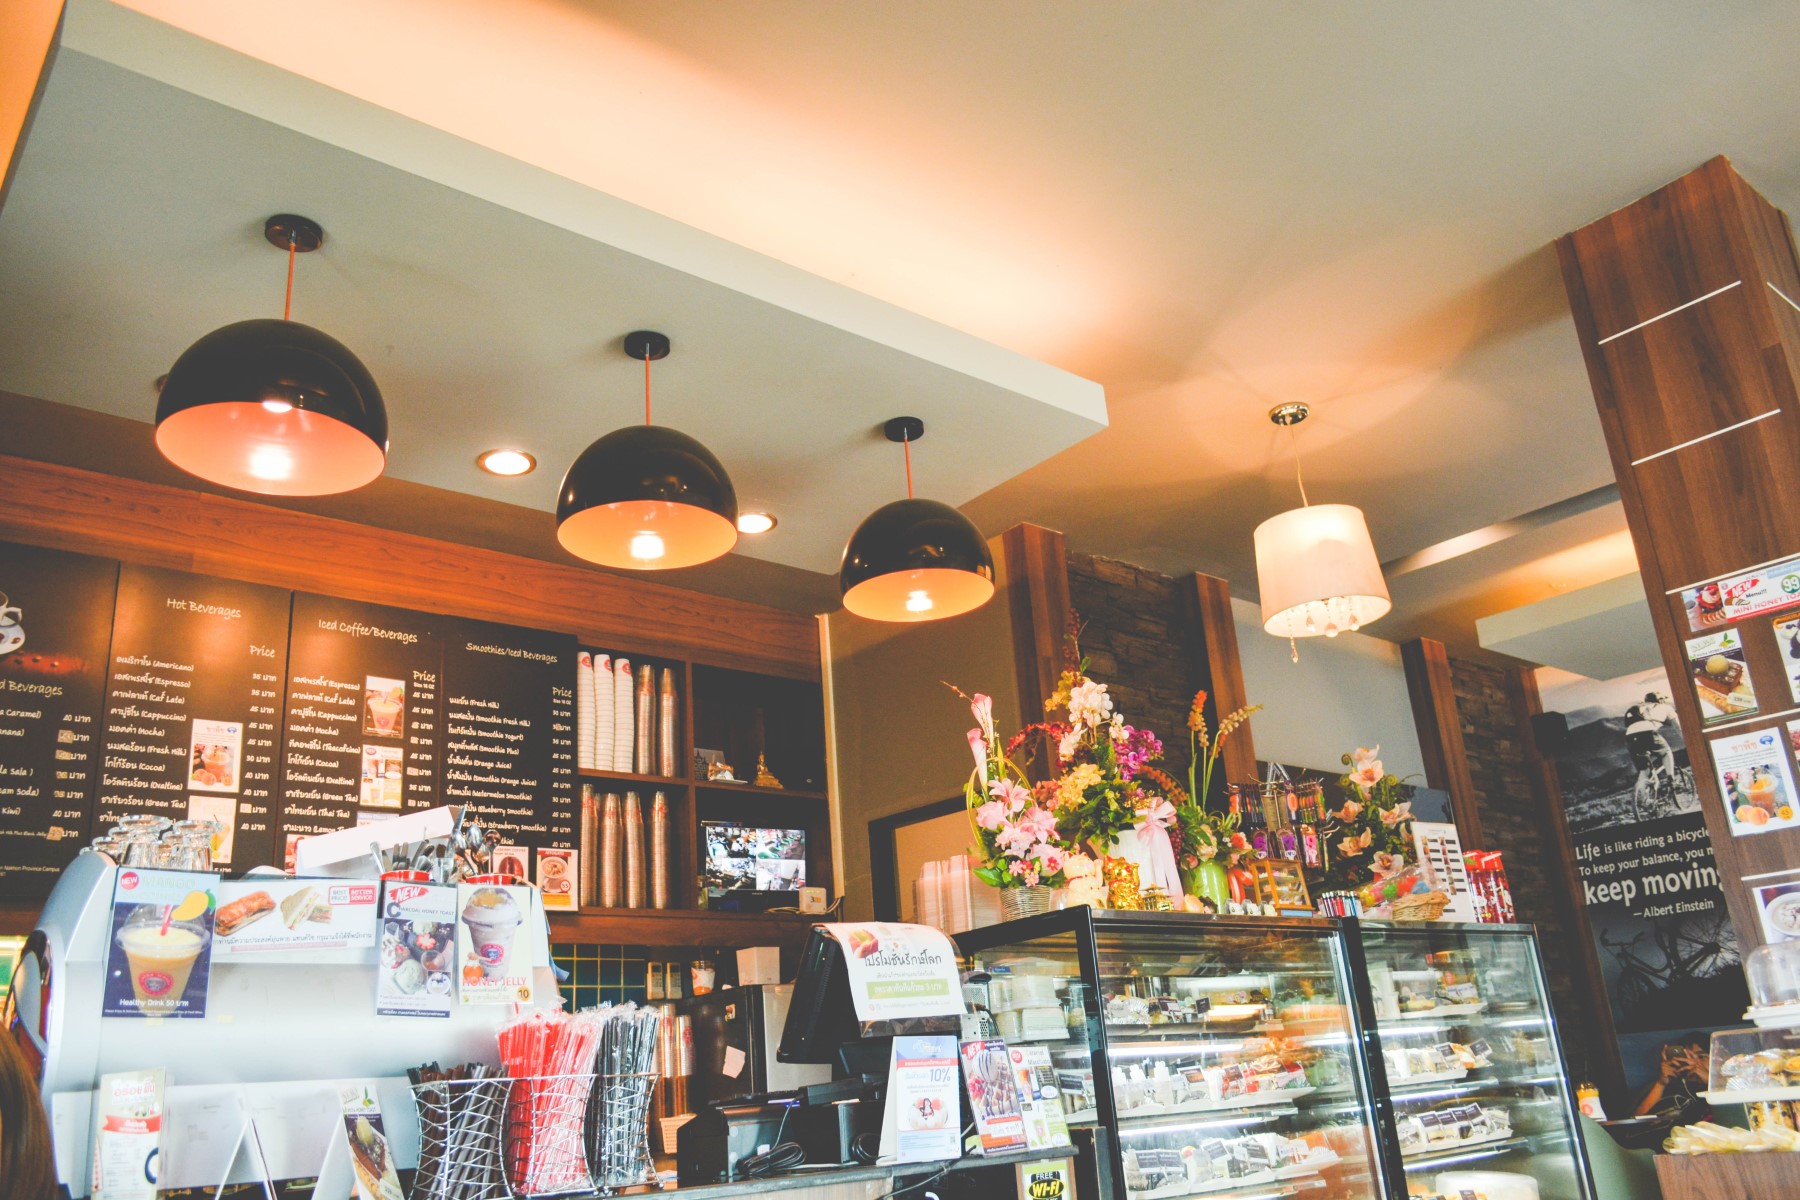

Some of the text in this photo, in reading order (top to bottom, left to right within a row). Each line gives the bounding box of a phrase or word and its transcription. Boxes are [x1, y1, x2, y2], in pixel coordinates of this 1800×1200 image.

[1731, 580, 1753, 597] NEW
[1782, 576, 1800, 591] 99
[166, 597, 242, 621] Hot Beverages
[1733, 596, 1783, 614] MINI HONEY
[318, 618, 419, 645] Iced Coffee/Beverages
[249, 644, 276, 658] Price
[465, 641, 559, 665] Smoothies/Iced Beverages
[152, 661, 195, 672] (Americano)
[412, 670, 436, 683] Price
[8, 680, 63, 698] Beverages
[154, 677, 191, 689] (Espresso)
[328, 679, 361, 692] (Espresso)
[551, 686, 573, 698] Price
[165, 695, 185, 705] Late)
[338, 696, 356, 706] Late)
[5, 708, 42, 720] Caramel)
[141, 710, 187, 722] (Cappuccino)
[317, 710, 358, 722] (Cappuccino)
[138, 725, 166, 737] (Mocha)
[314, 723, 340, 736] (Mocha)
[147, 744, 170, 755] (Fresh
[138, 762, 166, 773] (Cocoa)
[315, 758, 340, 769] (Cocoa)
[10, 767, 27, 777] Sala
[150, 779, 184, 791] (Ovaltine)
[325, 776, 355, 786] (Ovaltine)
[16, 785, 40, 797] Soda)
[322, 791, 344, 801] (Green
[344, 792, 359, 803] Tea)
[144, 797, 169, 808] (Green
[170, 799, 187, 810] Tea)
[1, 807, 21, 816] Kiwi)
[317, 807, 335, 818] (Thai
[335, 808, 351, 819] Tea)
[506, 805, 534, 817] Smoothie)
[520, 822, 548, 833] Smoothie)
[1575, 842, 1601, 861] Life
[1604, 843, 1613, 855] is
[1614, 840, 1634, 853] like
[1634, 835, 1666, 850] riding
[1666, 834, 1674, 843] a
[1578, 866, 1592, 877] To
[1592, 863, 1616, 875] keep
[1617, 858, 1640, 873] your
[1641, 851, 1684, 866] balance,
[1684, 846, 1705, 862] you
[120, 875, 139, 886] NEW
[1582, 861, 1725, 907] keep movin
[396, 886, 421, 902] NEW
[1675, 898, 1715, 913] Einstein
[462, 976, 528, 987] HONEY JELLY
[518, 989, 530, 1000] 10
[119, 998, 189, 1008] Healthy Drink 50 บาท
[966, 1041, 983, 1058] NEW
[929, 1068, 952, 1083] 10%
[1035, 1172, 1054, 1180] FREE
[1032, 1181, 1061, 1198] WI-FI
